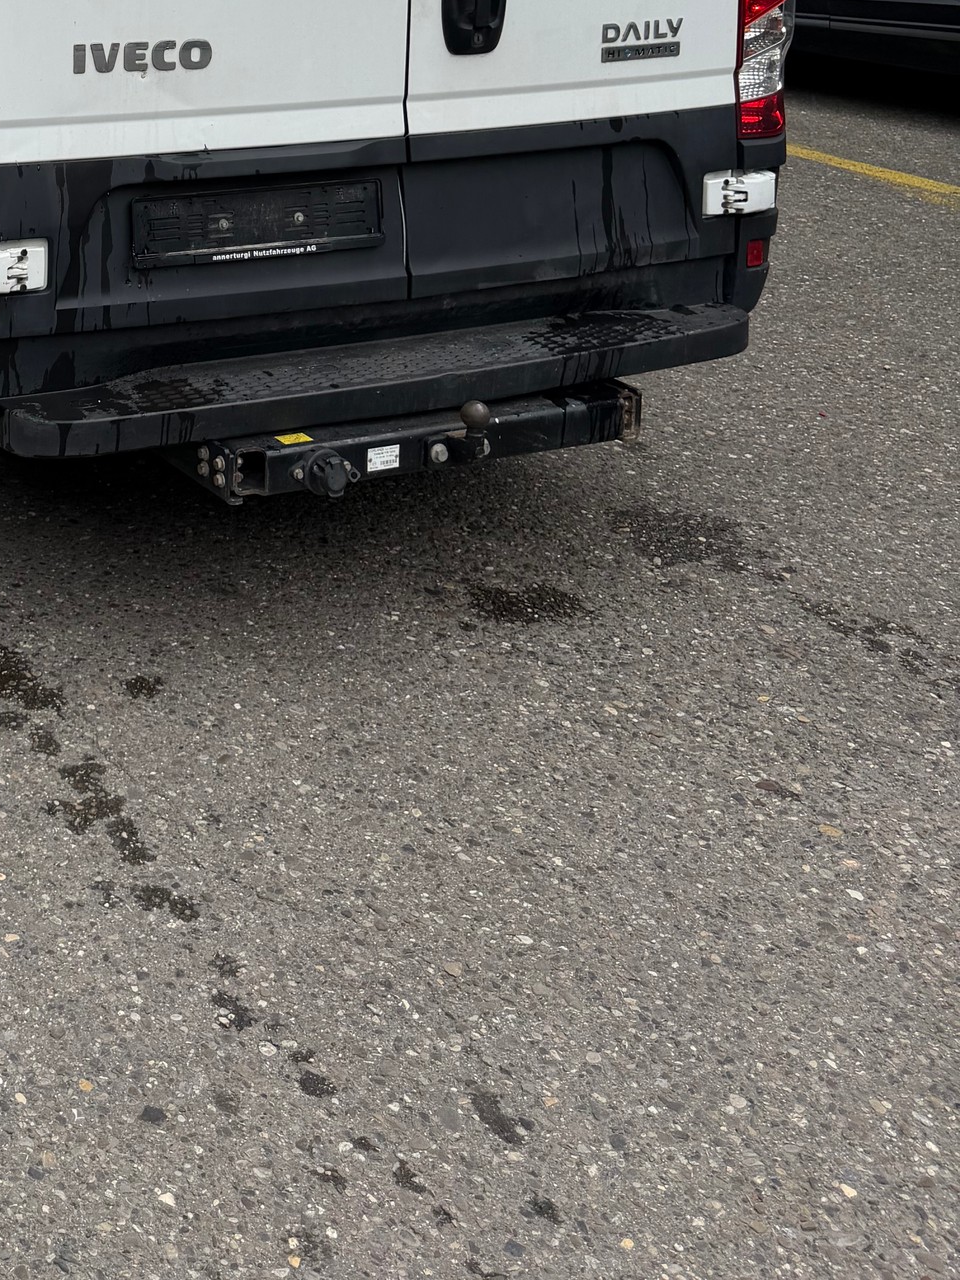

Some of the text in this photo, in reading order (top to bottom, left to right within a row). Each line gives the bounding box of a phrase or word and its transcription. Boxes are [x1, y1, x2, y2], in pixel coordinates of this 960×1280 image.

[601, 17, 683, 43] DAILY
[73, 38, 212, 74] IVECO
[306, 244, 317, 252] AG
